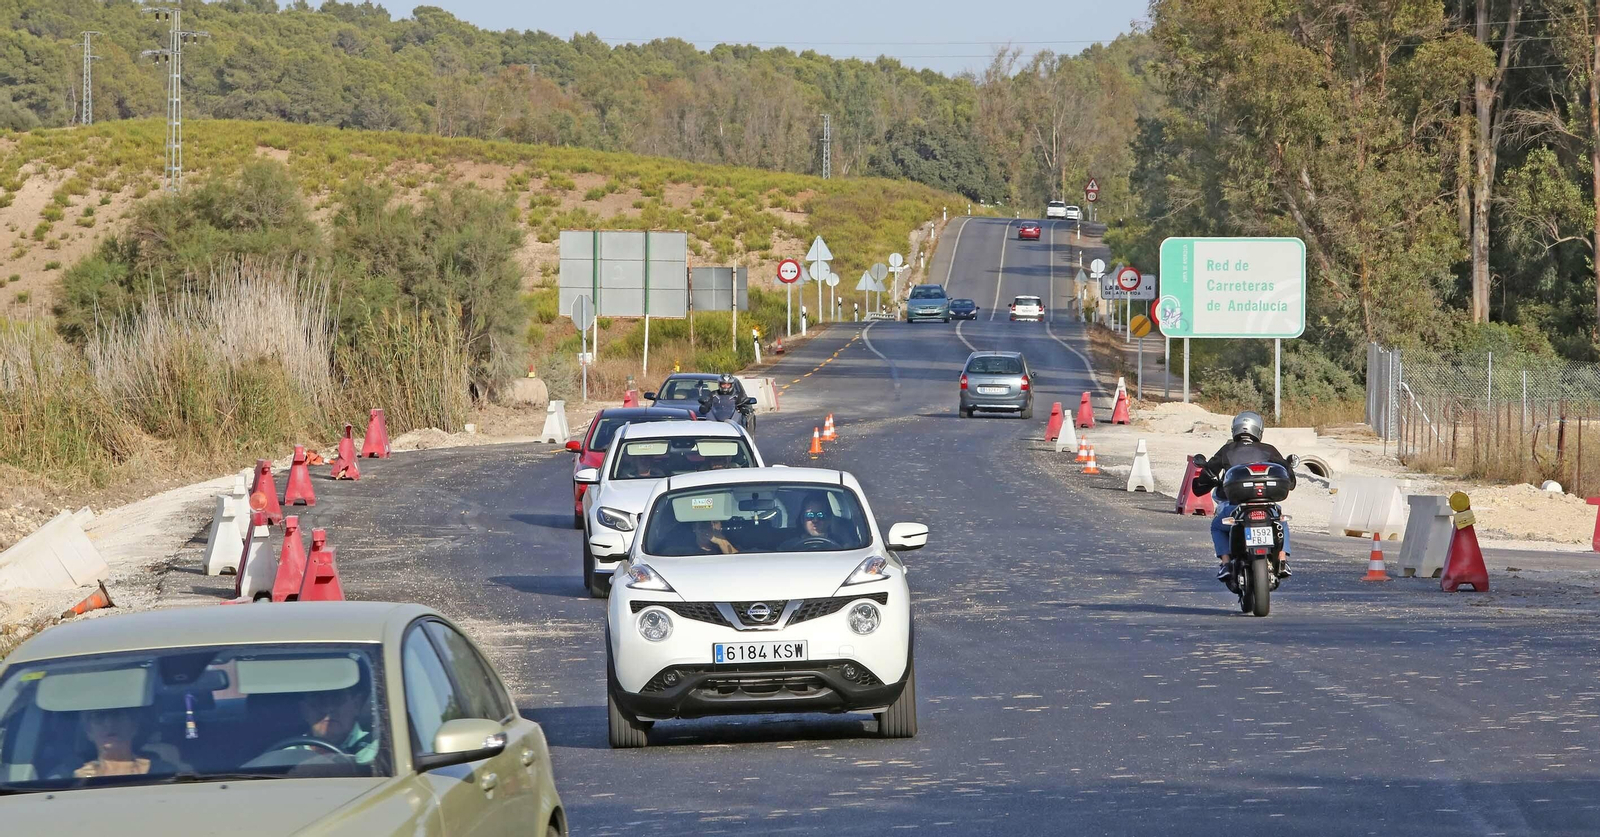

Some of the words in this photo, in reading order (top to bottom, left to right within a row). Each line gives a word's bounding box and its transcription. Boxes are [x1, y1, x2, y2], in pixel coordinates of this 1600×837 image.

[1207, 260, 1228, 271] Red
[1235, 260, 1249, 271] de
[1207, 280, 1274, 292] Carreteras
[1207, 300, 1220, 312] de
[1228, 300, 1288, 312] Andalucía
[1252, 528, 1271, 536] 1592
[726, 644, 767, 660] 6184
[774, 644, 803, 658] KSW
